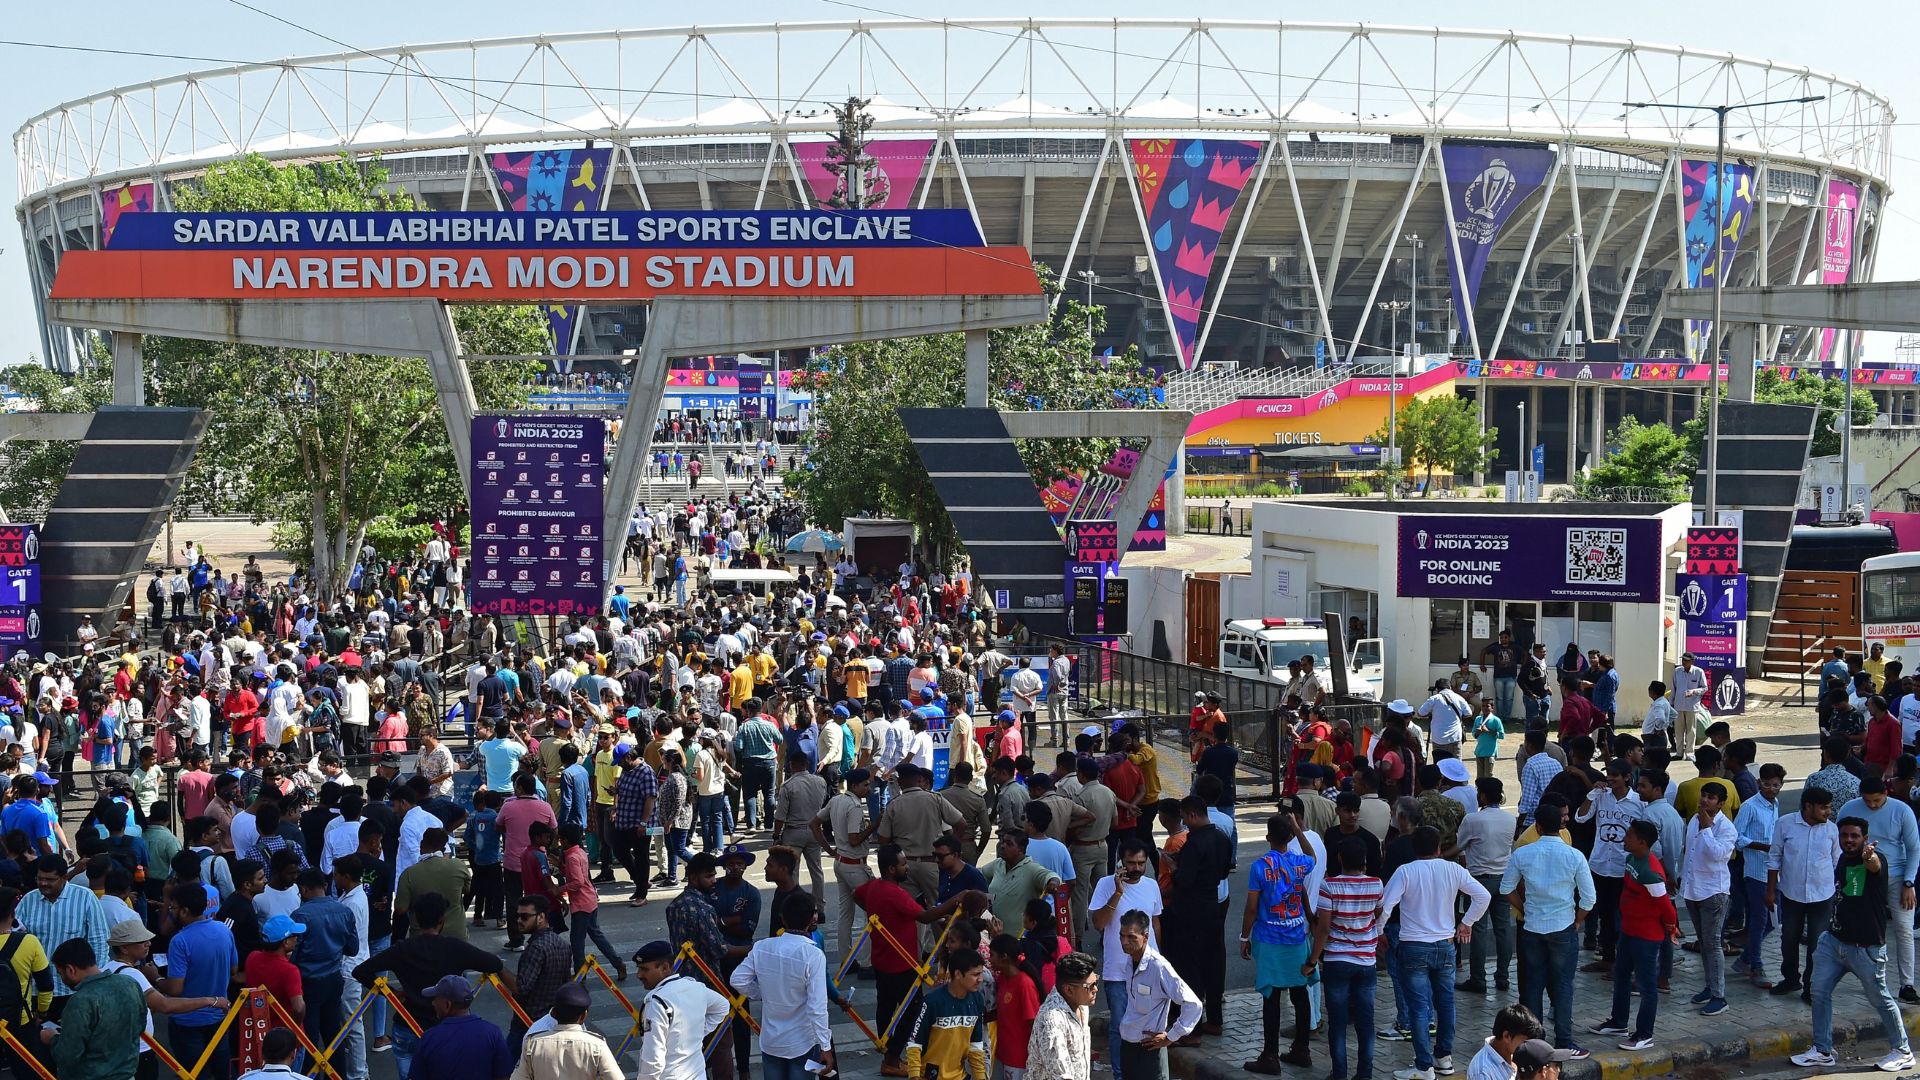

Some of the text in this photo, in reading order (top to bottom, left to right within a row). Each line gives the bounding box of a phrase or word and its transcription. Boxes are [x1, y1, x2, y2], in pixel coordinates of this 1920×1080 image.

[174, 216, 911, 242] SARDAR VALLABHBHAI PATEL SPORTS ENCLAVE
[1456, 229, 1477, 242] NDIA
[233, 256, 854, 289] NARENDRA MODI STADIUM
[1359, 383, 1381, 391] INDIA
[742, 397, 758, 406] 1-A
[1256, 404, 1292, 413] #CWC23
[514, 428, 583, 439] INDIA 2023
[1275, 432, 1321, 444] TICKETS
[1435, 539, 1509, 550] INDIA 2023
[1072, 566, 1094, 574] GATE
[1420, 560, 1501, 571] FOR ONLINE
[8, 569, 32, 577] GATE
[1427, 574, 1493, 585] BOOKING
[12, 579, 26, 601] 1
[1724, 587, 1734, 609] 1
[1867, 624, 1920, 635] GUJARAT POLI
[932, 731, 950, 743] AY
